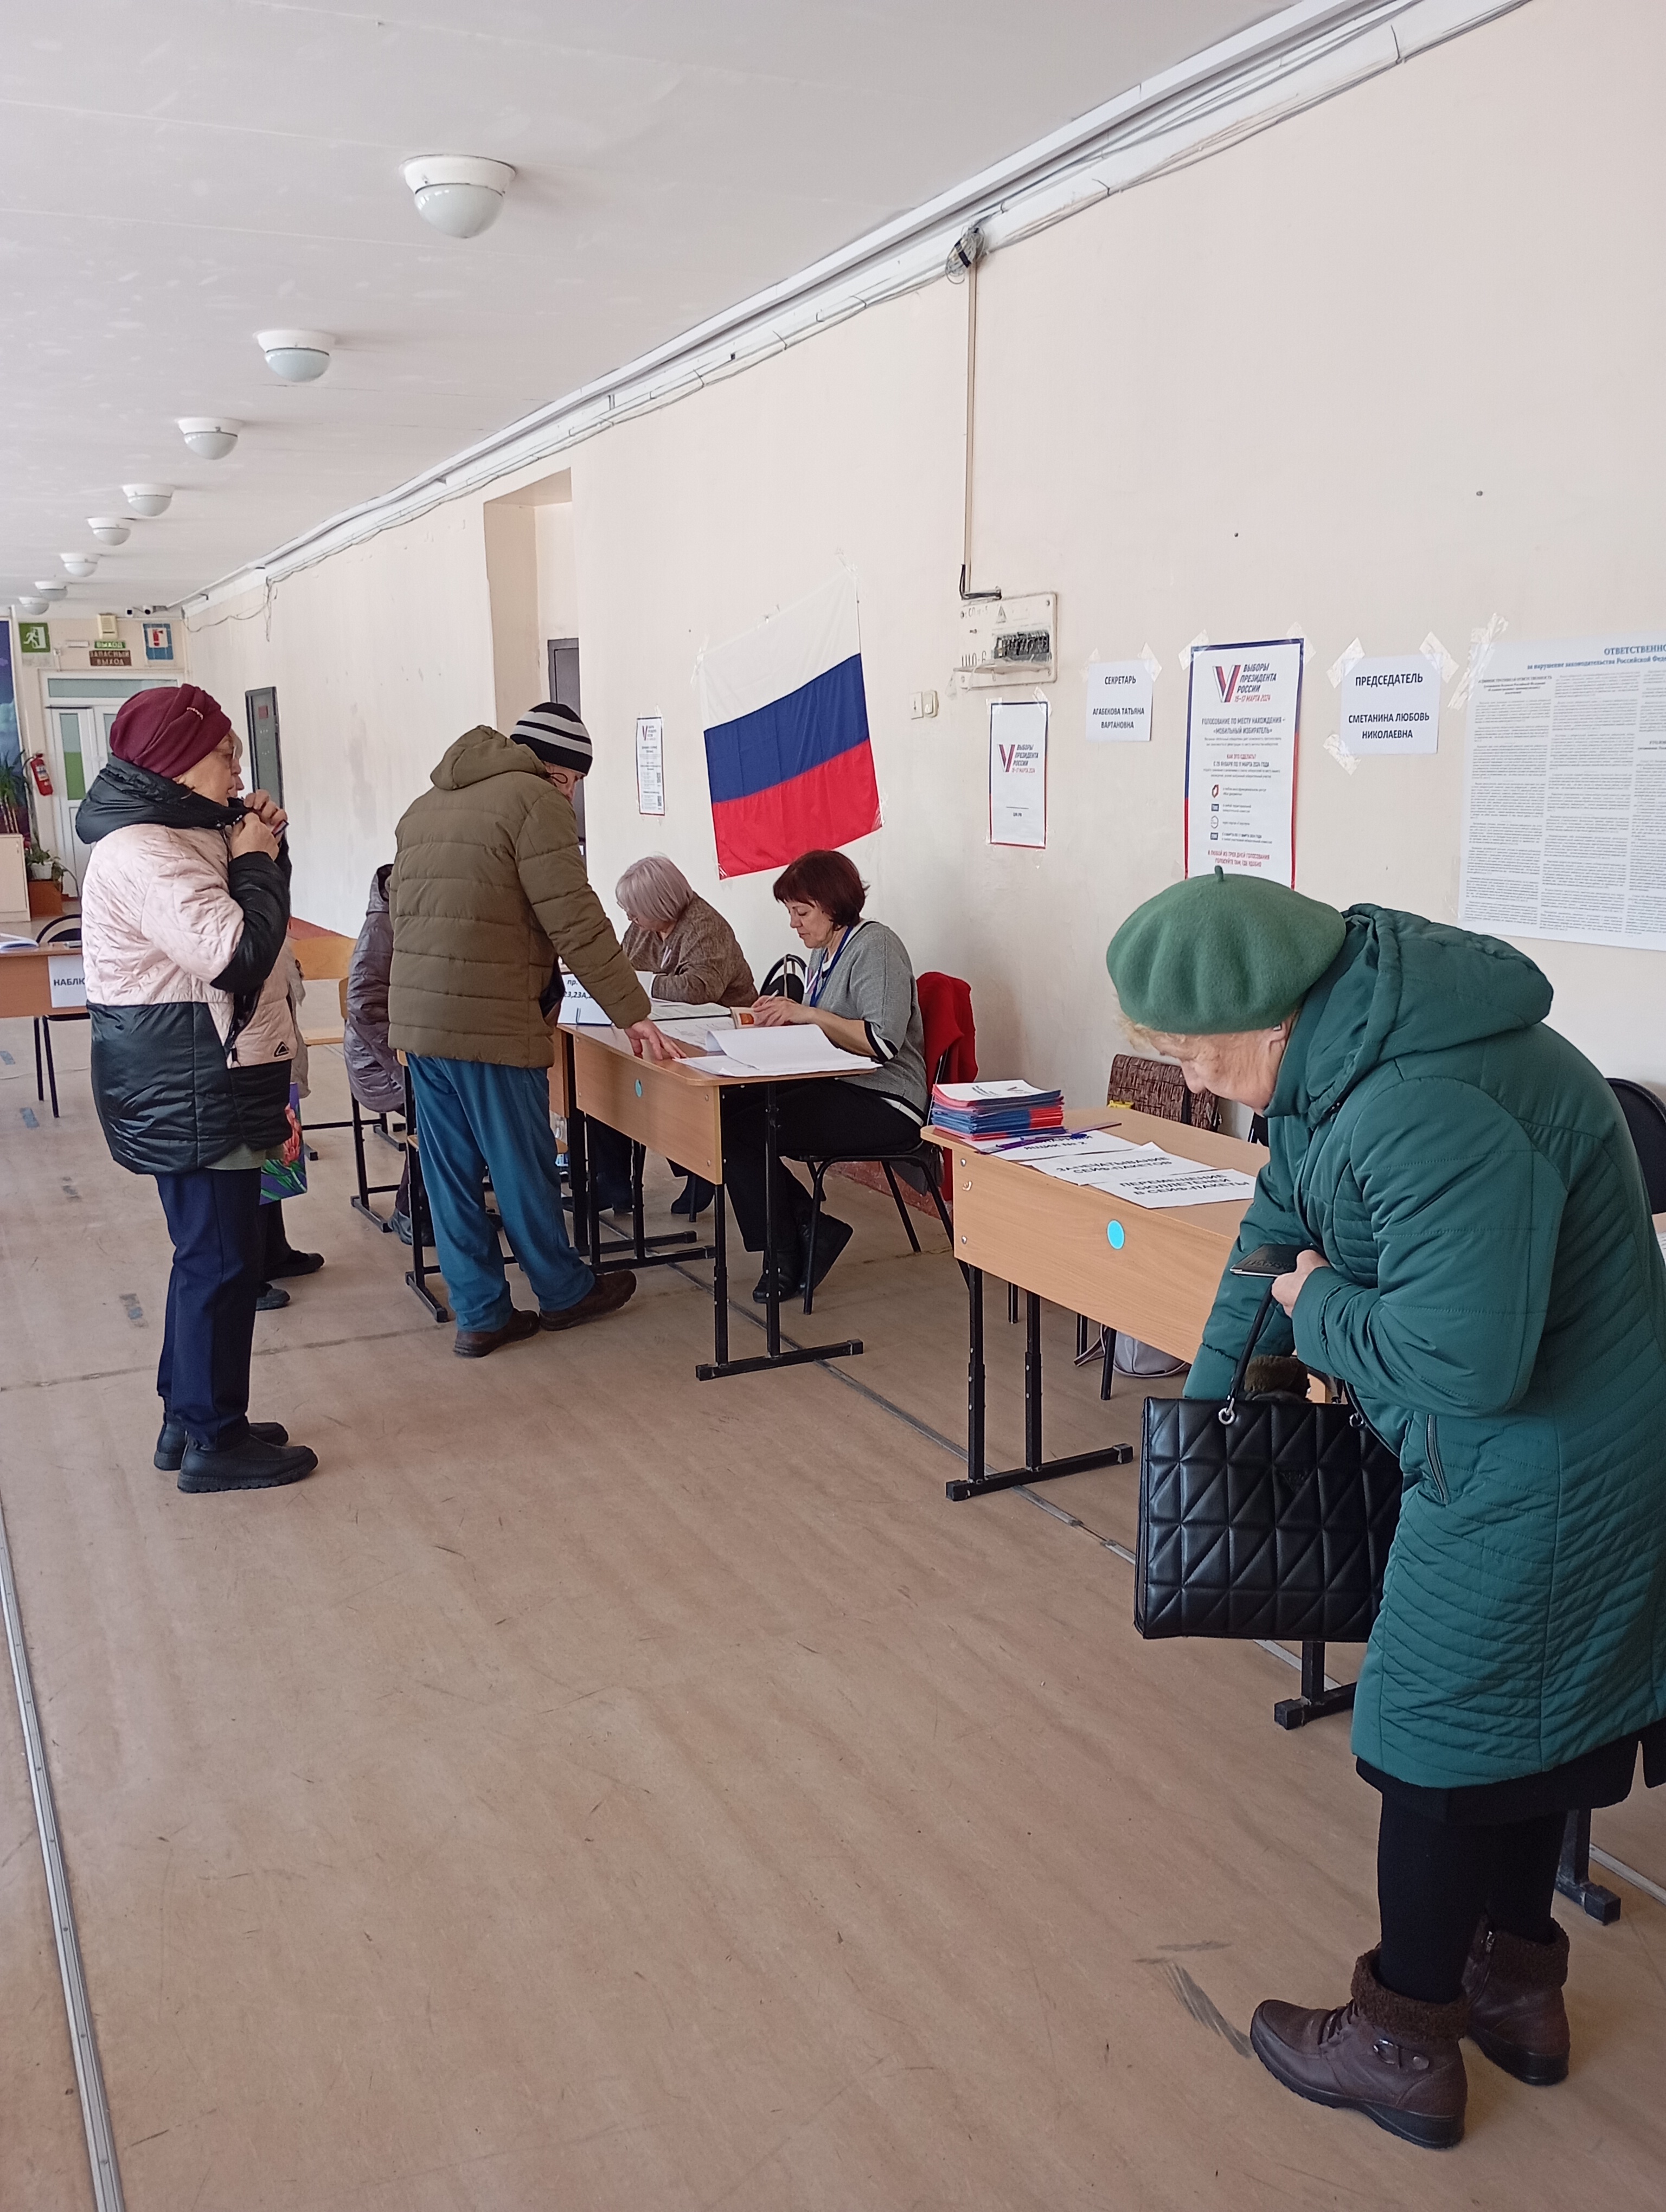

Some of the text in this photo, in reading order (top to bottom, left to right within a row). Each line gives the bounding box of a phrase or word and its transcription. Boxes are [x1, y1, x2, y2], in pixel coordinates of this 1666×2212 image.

[1243, 663, 1270, 672] ВЫБОРЫ
[1565, 659, 1615, 668] законодательства
[1105, 676, 1136, 685] СЕКРЕТАРЬ
[1240, 673, 1277, 683] ПРЕЗИДЕНТА
[1355, 673, 1423, 687] ПРЕДСЕДАТЕЛЬ
[1237, 685, 1260, 693] РОССИИ
[1348, 712, 1430, 723] СМЕТАНИНА ЛЮБОВЬ
[1362, 730, 1413, 739] НИКОЛАЕВНА
[1056, 1156, 1170, 1172] ЗАПЕЧАТЫВАНИЕ
[1073, 1161, 1172, 1174] СЕЙФ-ПАКЕТОВ
[1119, 1174, 1227, 1187] ПЕРЕМЕЩЕНИЕ
[1134, 1179, 1232, 1191] БЮЛЛЕТЕНЕЙ
[1147, 1182, 1250, 1194] СЕЙФ-ПАКЕТЫ
